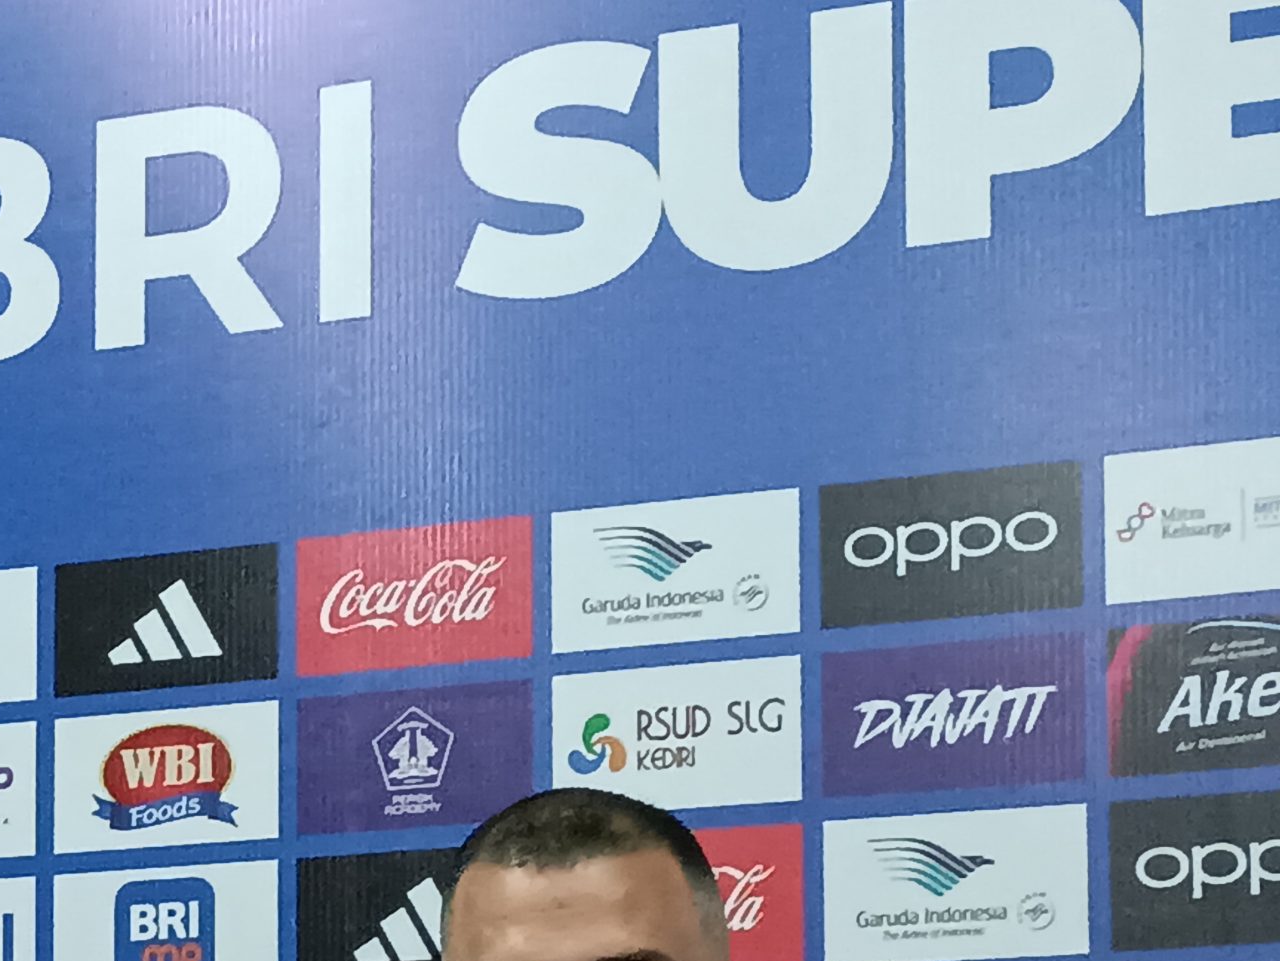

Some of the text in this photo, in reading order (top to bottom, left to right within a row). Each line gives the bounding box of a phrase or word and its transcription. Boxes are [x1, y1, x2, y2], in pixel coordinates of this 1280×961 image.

[455, 0, 1280, 300] SUPE
[844, 511, 1058, 576] oppo
[319, 556, 507, 634] Coca-Cola
[582, 589, 724, 614] Garuda Indonesia
[637, 698, 786, 742] RSUD SLG
[1157, 669, 1280, 733] Ake
[120, 741, 216, 789] WBI
[637, 745, 695, 771] KEDIRI
[129, 796, 201, 828] Foods
[129, 900, 199, 942] BRI
[856, 906, 1007, 929] Garuda Indonesia
